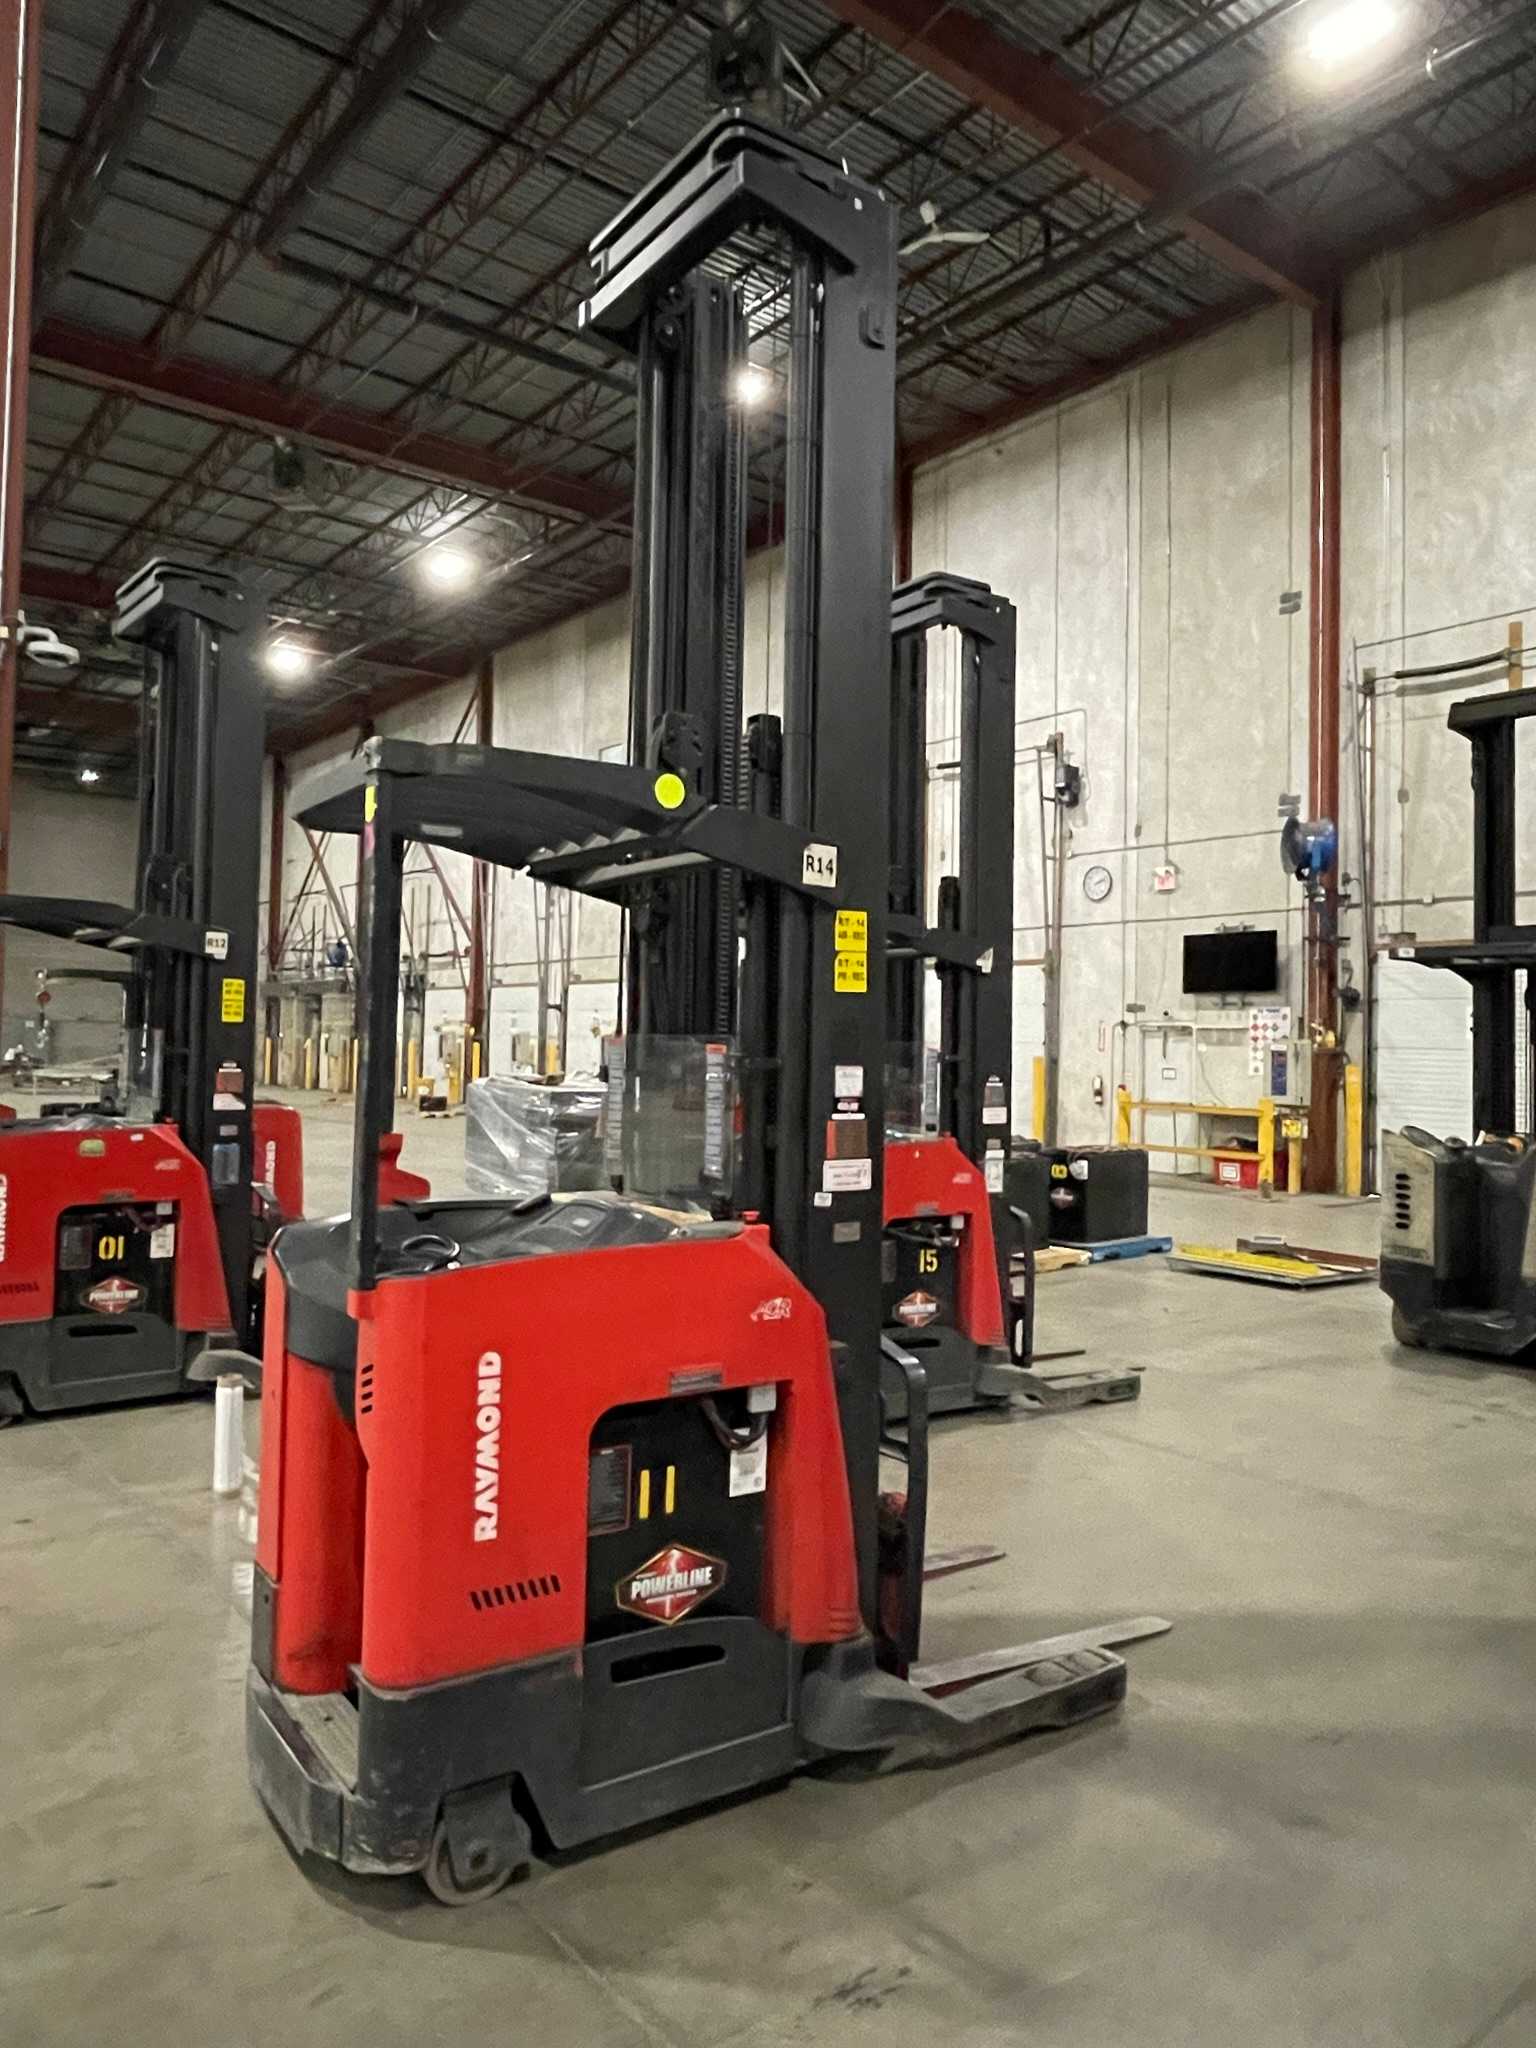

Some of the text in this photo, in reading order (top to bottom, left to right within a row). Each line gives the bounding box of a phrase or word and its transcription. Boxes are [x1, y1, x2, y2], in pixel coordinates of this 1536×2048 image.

[805, 854, 834, 876] R14
[99, 1235, 125, 1260] 01
[919, 1249, 939, 1273] 15
[474, 1351, 502, 1542] RAYMOND
[639, 1465, 676, 1519] 11
[630, 1566, 713, 1601] POWERLINE
